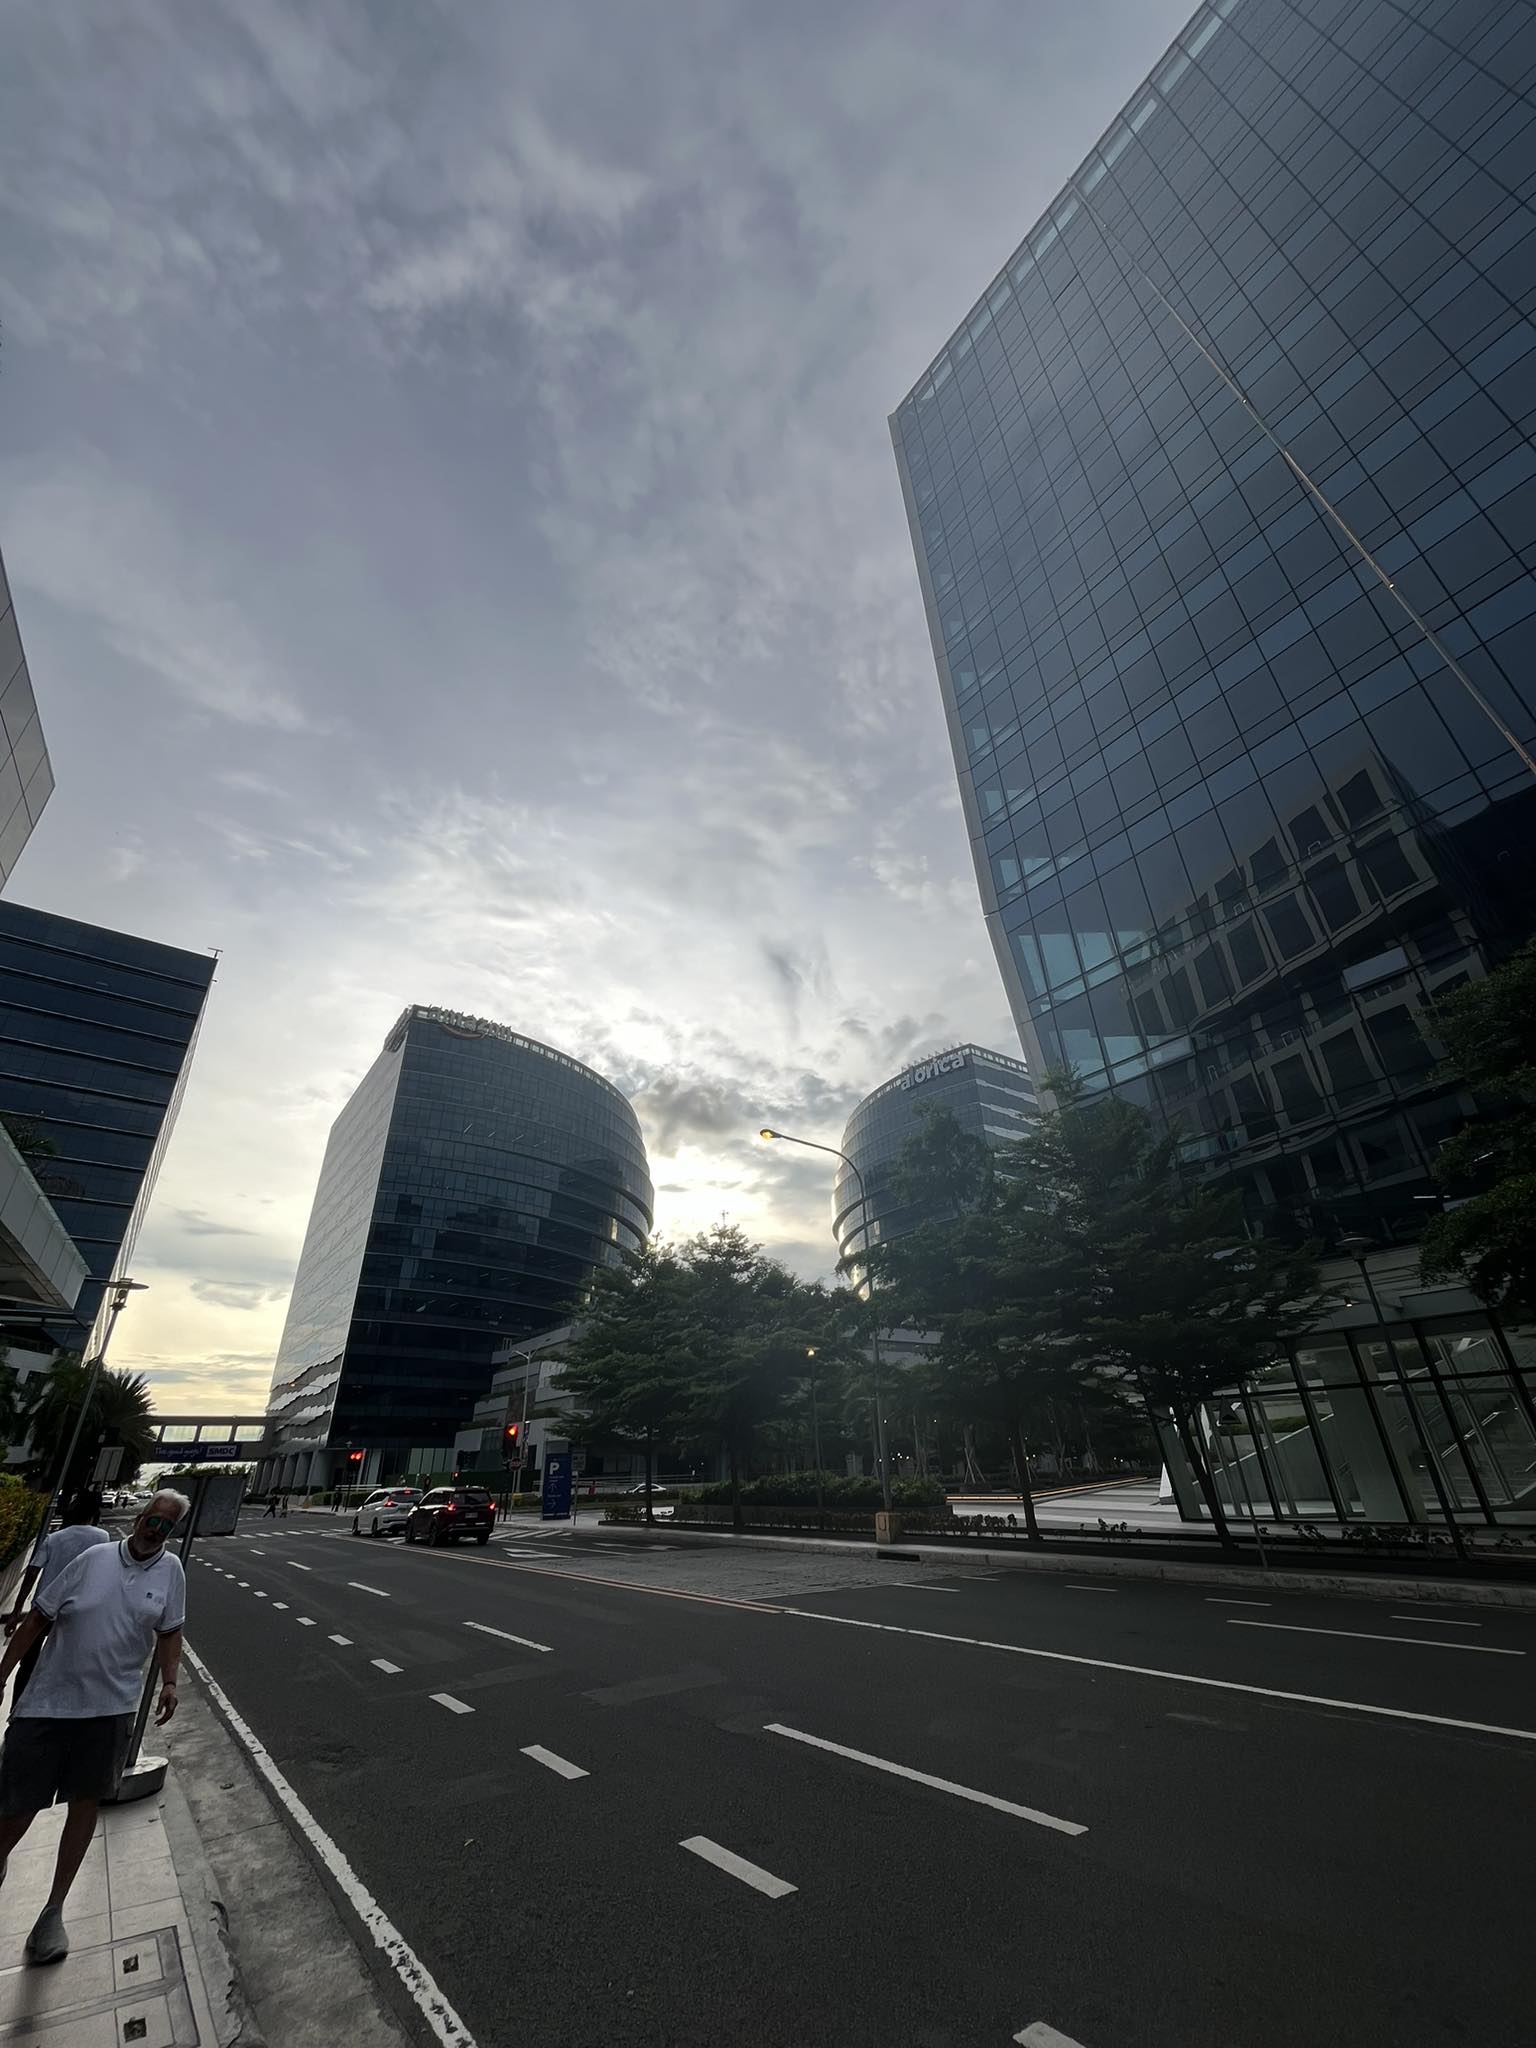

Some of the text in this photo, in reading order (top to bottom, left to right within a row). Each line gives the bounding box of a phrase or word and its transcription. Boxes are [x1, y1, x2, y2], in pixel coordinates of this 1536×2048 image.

[901, 1053, 965, 1091] alorica
[208, 1447, 235, 1455] SMDC
[549, 1461, 560, 1475] P
